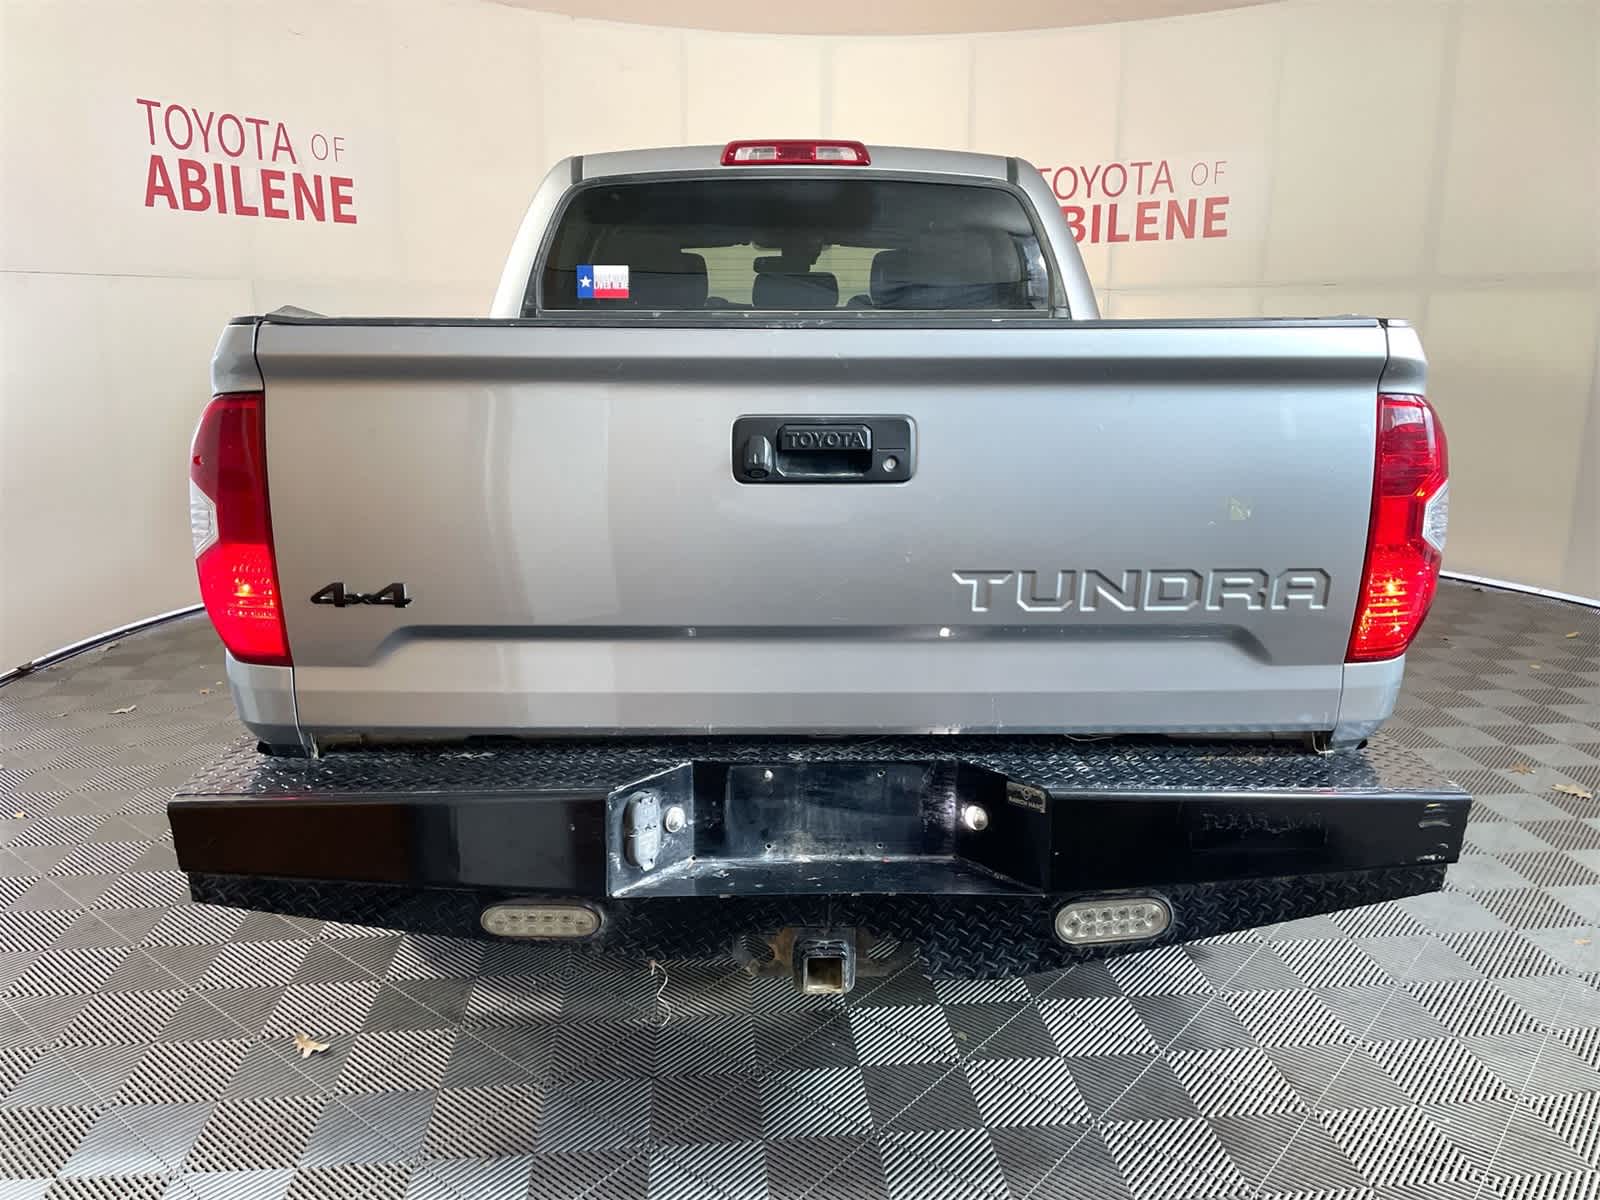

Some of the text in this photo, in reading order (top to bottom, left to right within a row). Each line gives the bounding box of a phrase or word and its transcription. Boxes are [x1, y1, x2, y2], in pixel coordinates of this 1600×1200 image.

[136, 98, 345, 165] TOYOTA OF
[145, 154, 357, 224] ABILENE
[1191, 160, 1228, 187] OF
[1058, 196, 1230, 244] BILENE
[786, 431, 866, 449] TOYOTA
[952, 568, 1331, 612] TUNDRA
